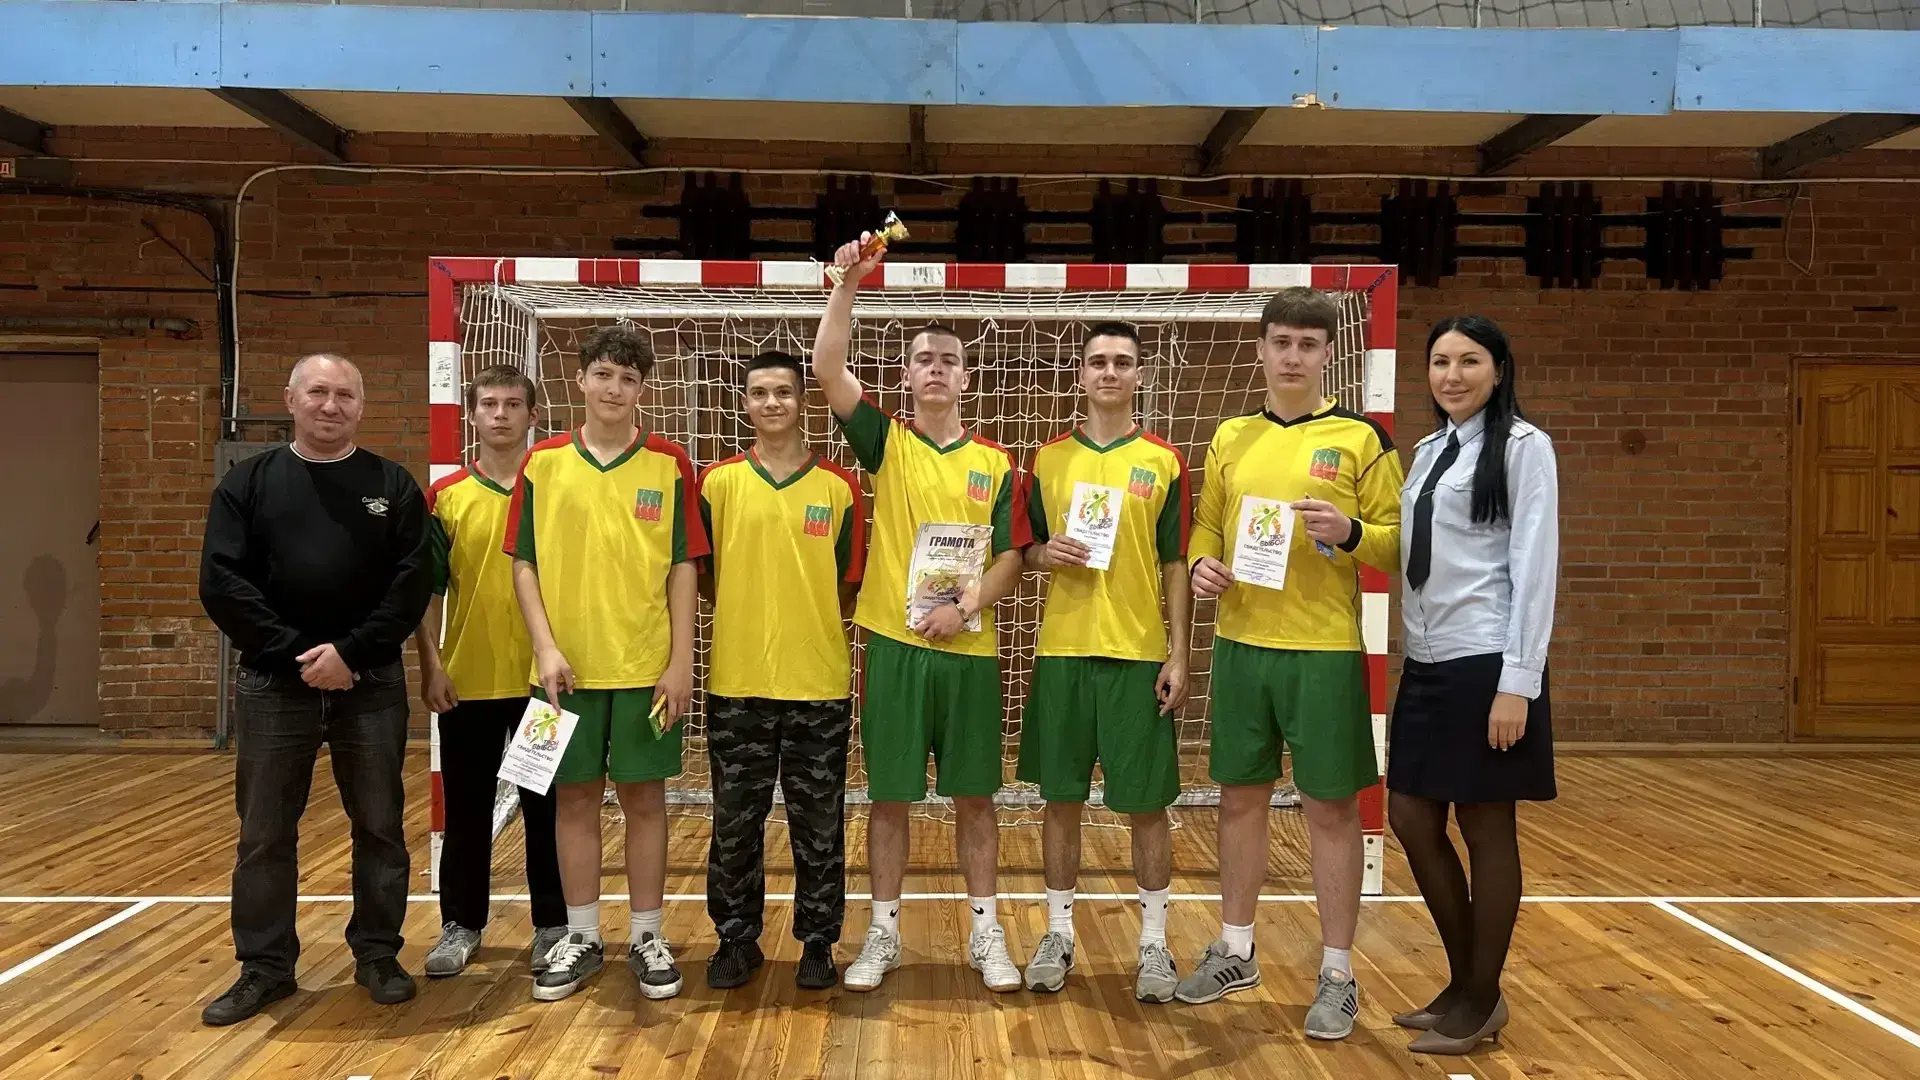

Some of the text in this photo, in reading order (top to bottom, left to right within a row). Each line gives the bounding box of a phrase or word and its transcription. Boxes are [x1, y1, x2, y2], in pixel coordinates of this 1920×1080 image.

[929, 536, 975, 549] ГРАМОТА
[1243, 543, 1283, 556] СВИДЕТЕЛЬСТВО
[516, 744, 555, 762] СВИДЕТЕЛЬСТВО
